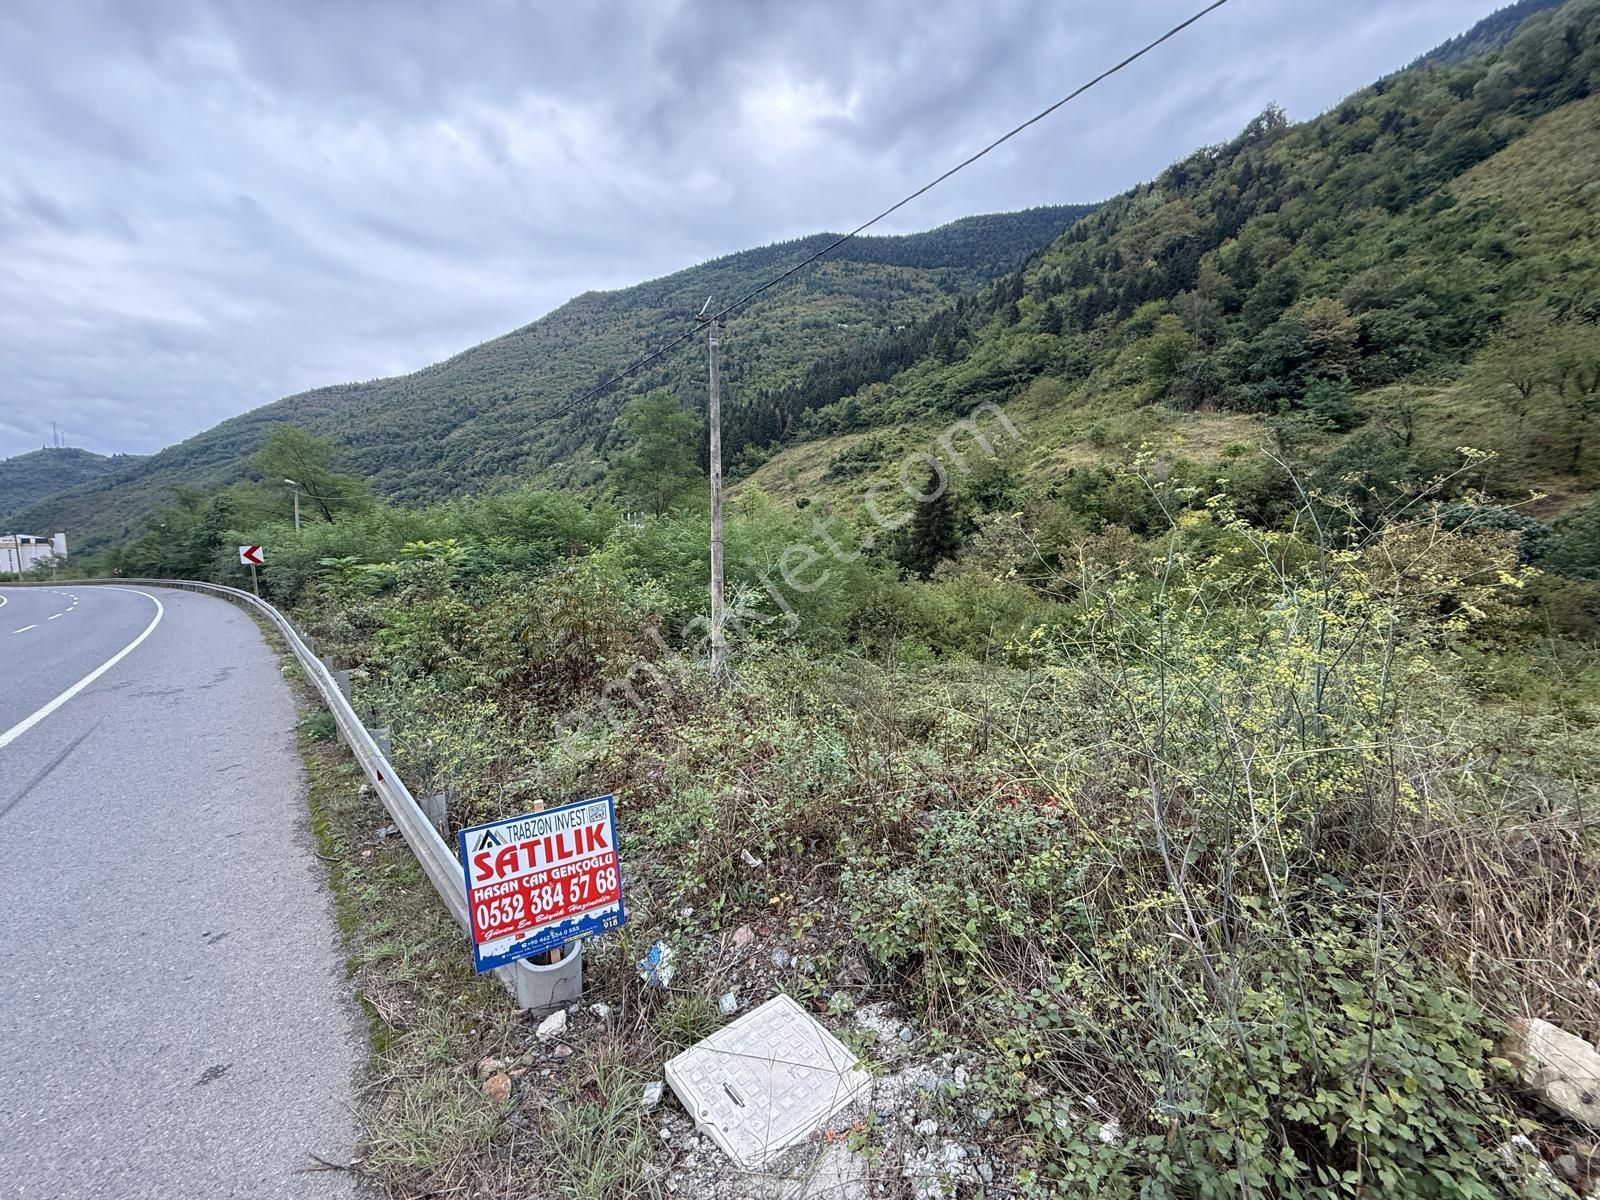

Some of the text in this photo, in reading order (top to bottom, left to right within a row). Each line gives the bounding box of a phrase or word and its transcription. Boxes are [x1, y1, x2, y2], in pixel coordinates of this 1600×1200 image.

[507, 808, 586, 842] TRABZON INVEST
[474, 823, 608, 881] SATILIK
[475, 880, 518, 902] HASAN
[522, 872, 547, 888] CAN
[476, 867, 617, 930] 0532 384 57 68
